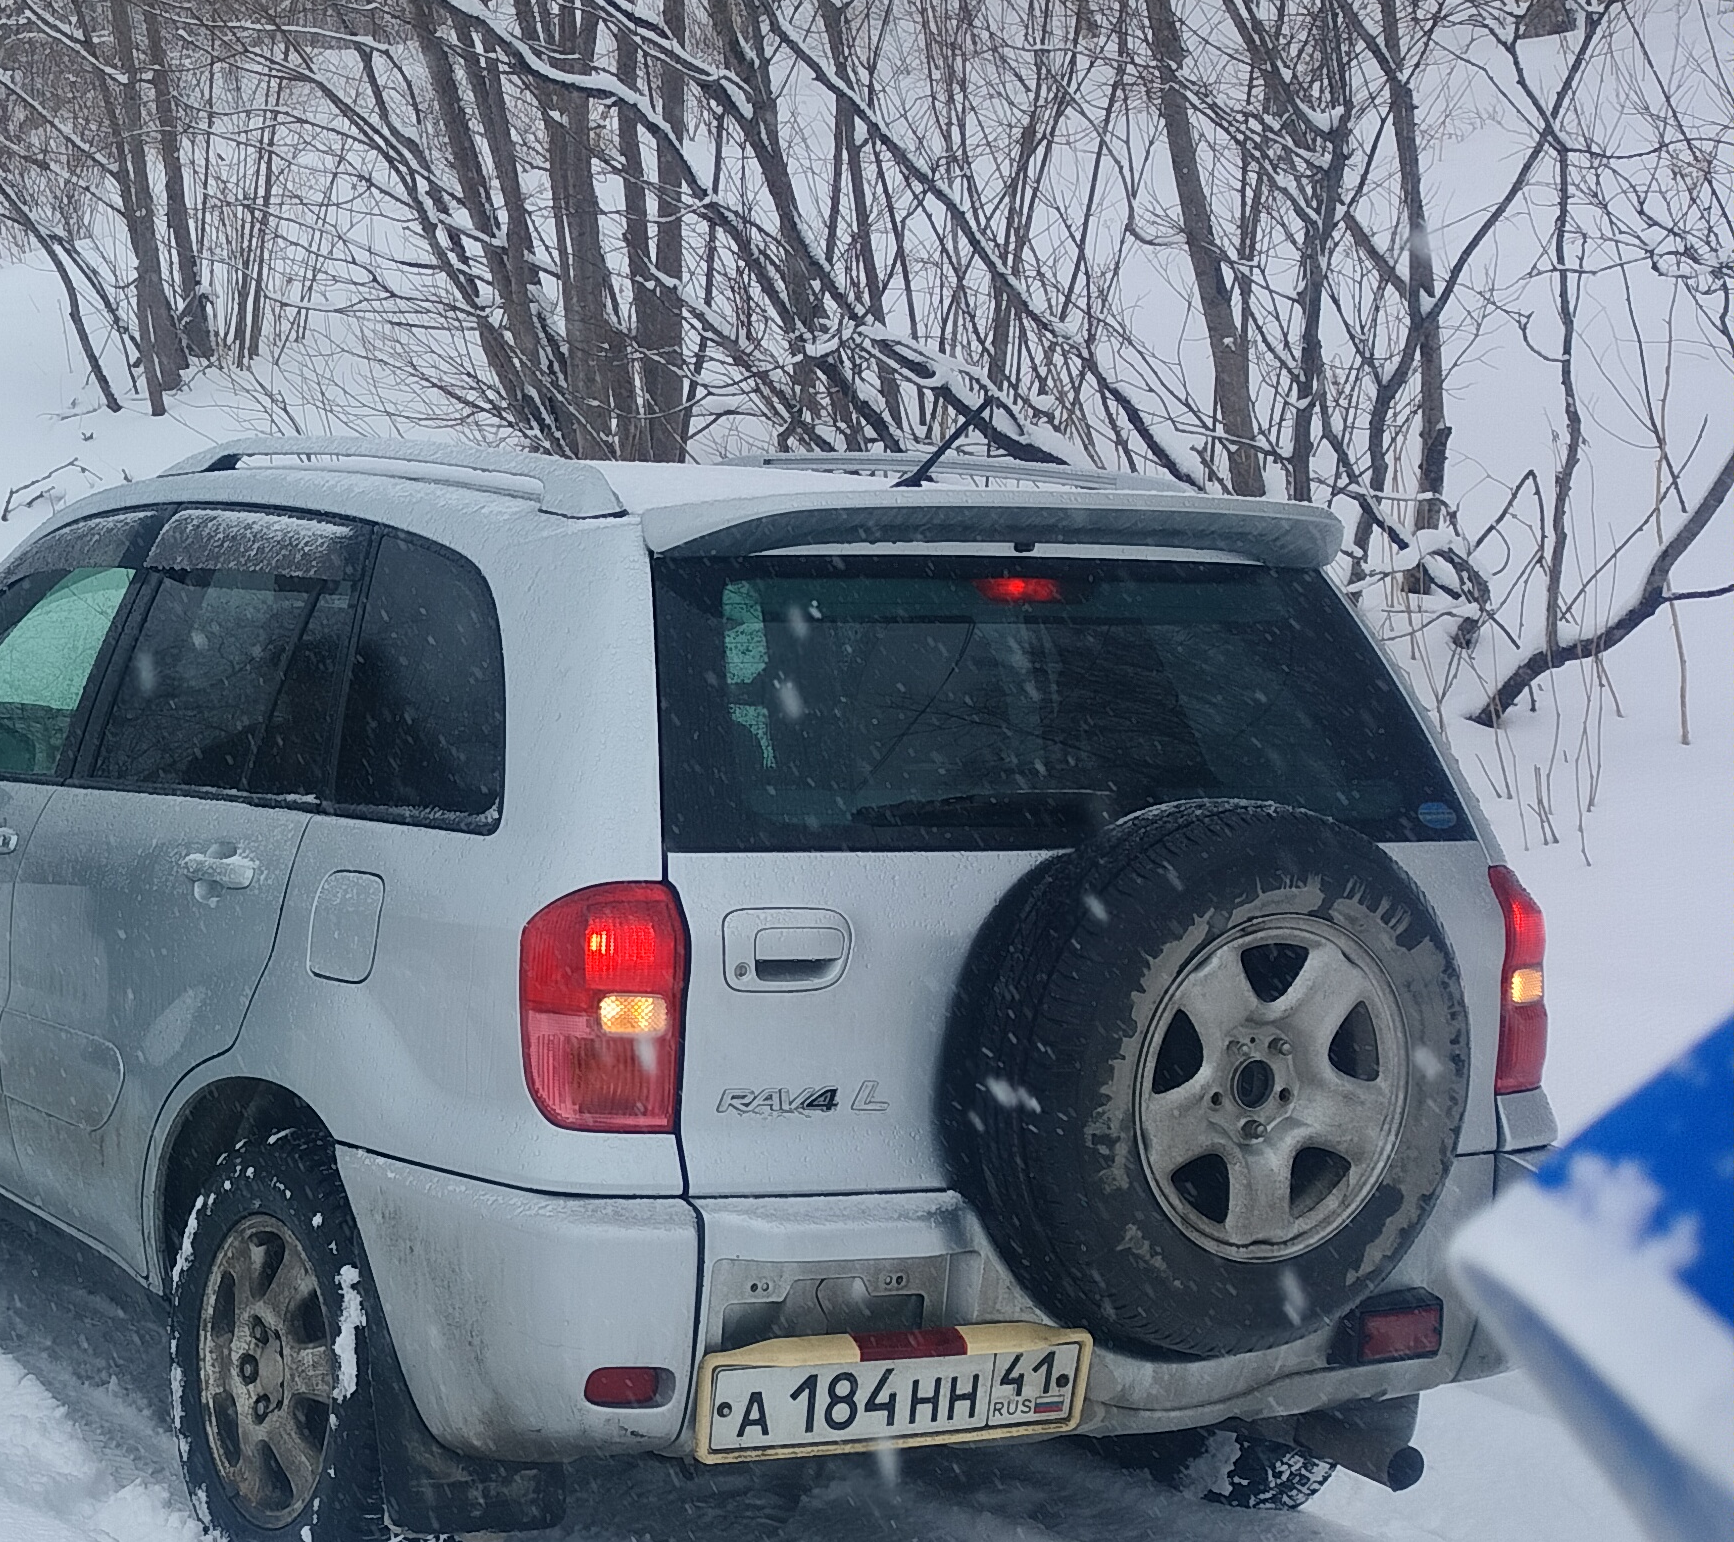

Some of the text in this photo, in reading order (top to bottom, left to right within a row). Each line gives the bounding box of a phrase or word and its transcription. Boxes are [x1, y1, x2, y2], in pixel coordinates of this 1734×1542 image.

[716, 1079, 890, 1114] RAV4 L
[999, 1351, 1056, 1397] 41
[992, 1399, 1033, 1417] RUS
